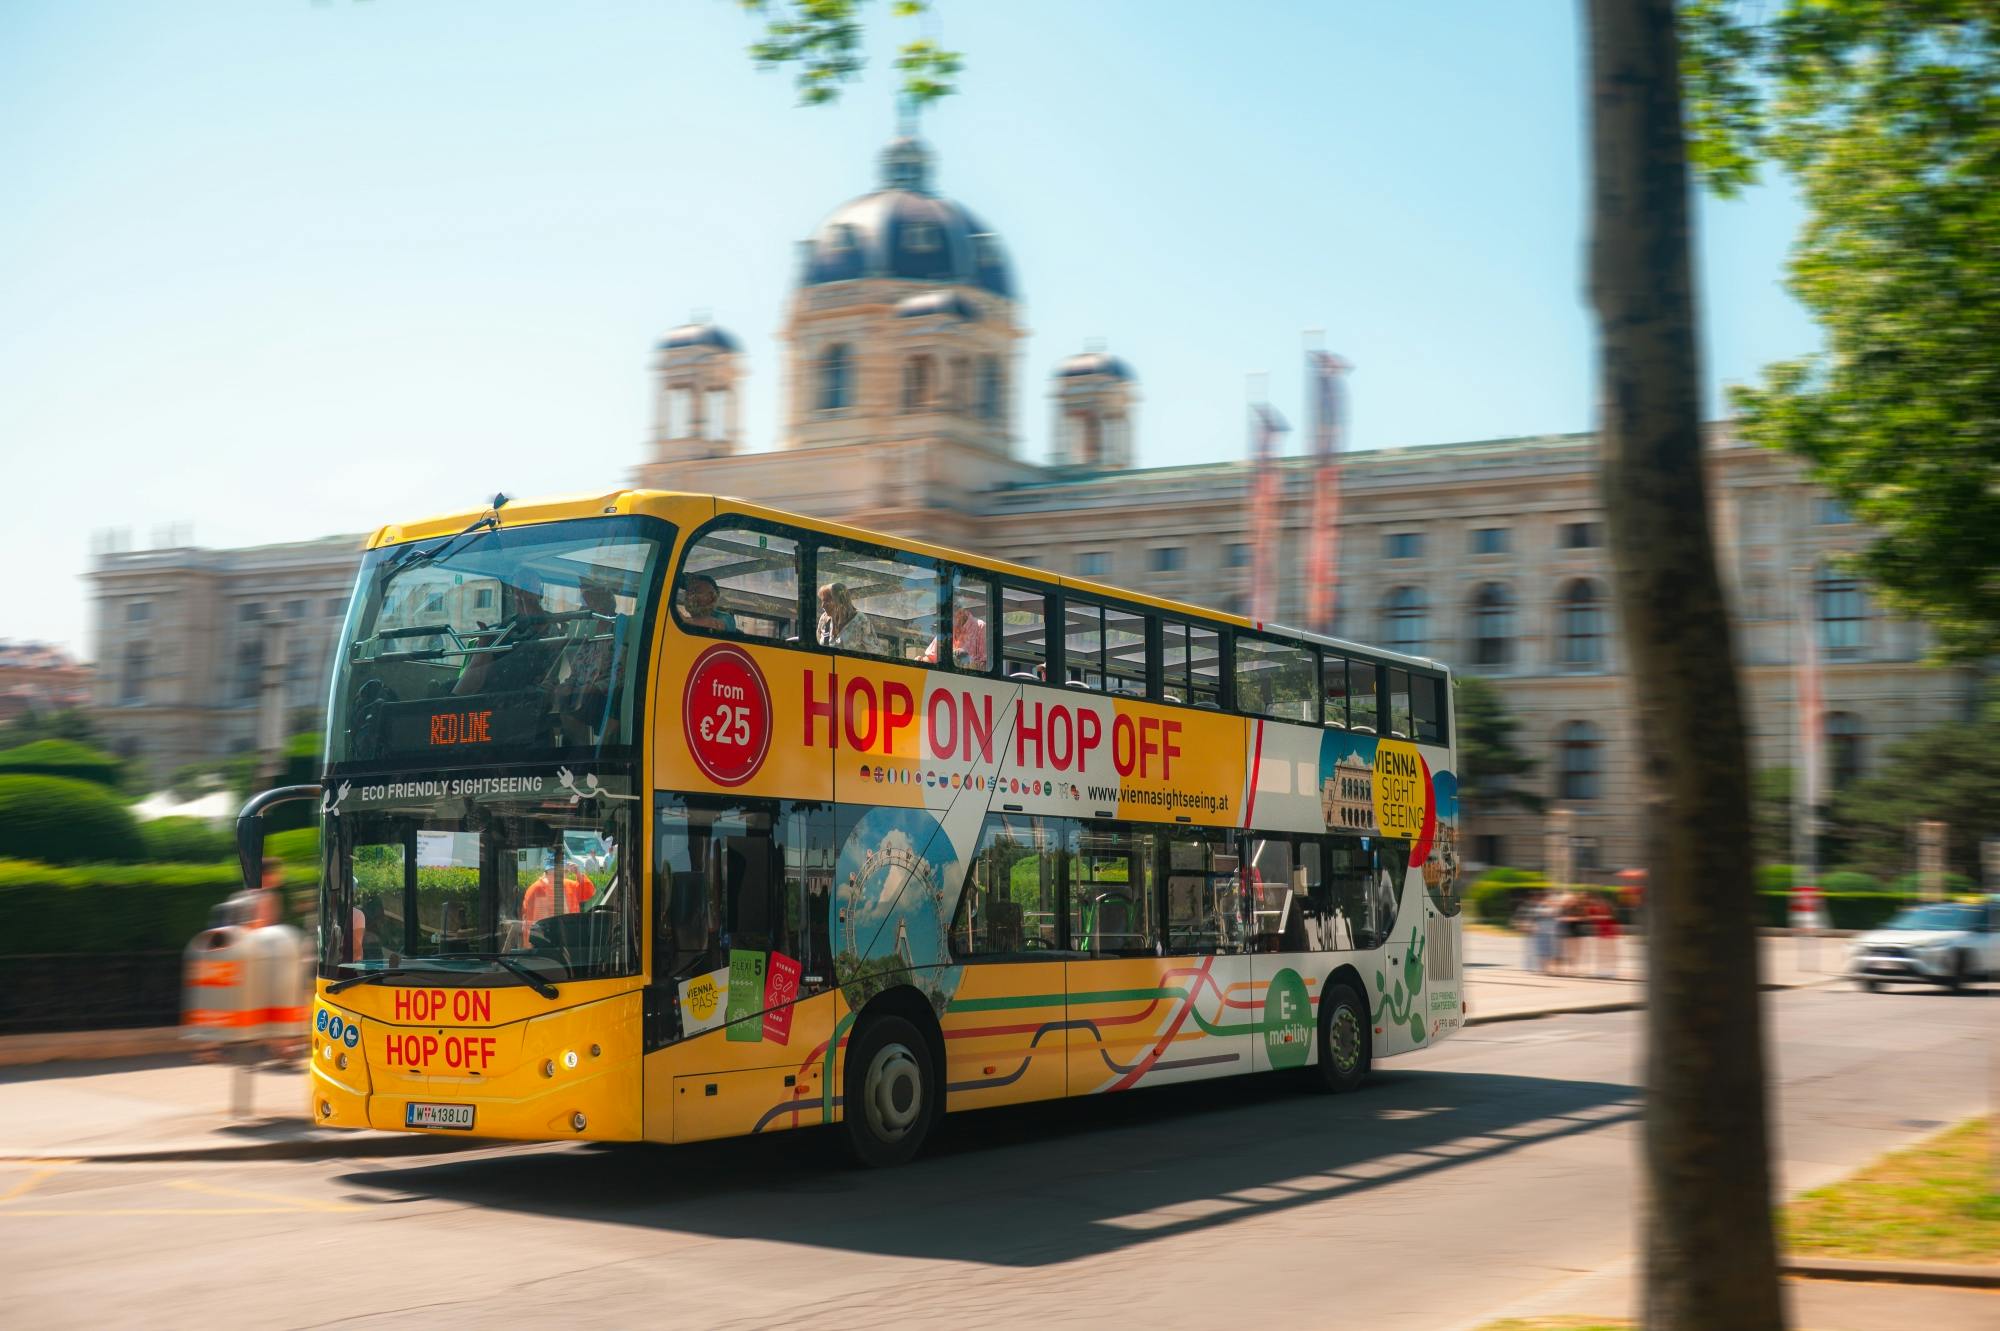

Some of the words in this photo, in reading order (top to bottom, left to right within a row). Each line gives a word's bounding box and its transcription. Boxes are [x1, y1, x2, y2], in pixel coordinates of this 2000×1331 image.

[712, 679, 744, 701] from
[431, 713, 457, 744] RED
[460, 711, 492, 743] LINE
[700, 704, 750, 746] €25
[803, 669, 914, 754] HOP
[927, 687, 993, 764] ON
[1016, 699, 1102, 773] HOP
[1112, 713, 1182, 781] OFF
[1374, 750, 1417, 779] VIENNA
[361, 785, 385, 801] ECO
[387, 780, 448, 799] FRIENDLY
[451, 776, 543, 795] SIGHTSEEING
[1088, 784, 1229, 814] www.viennasightseeing.at
[1382, 777, 1416, 804] SIGHT
[1382, 802, 1424, 829] SEEING
[754, 959, 762, 976] 5
[395, 989, 446, 1020] HOP
[453, 990, 491, 1021] ON
[687, 983, 714, 999] VIENNA
[1280, 990, 1296, 1019] E-
[1269, 1023, 1310, 1046] mobility
[386, 1034, 438, 1067] HOP
[445, 1037, 496, 1069] OFF
